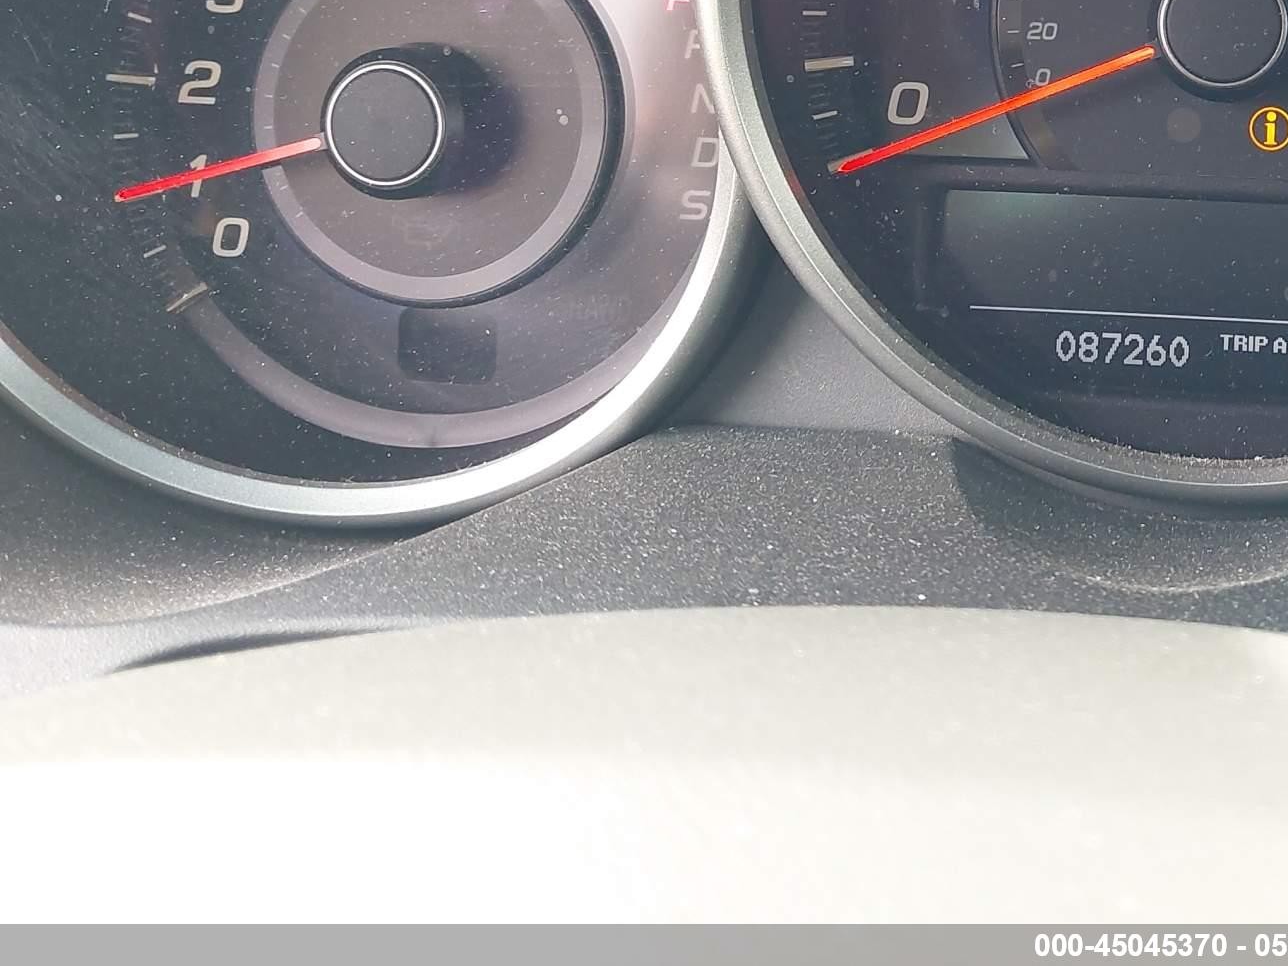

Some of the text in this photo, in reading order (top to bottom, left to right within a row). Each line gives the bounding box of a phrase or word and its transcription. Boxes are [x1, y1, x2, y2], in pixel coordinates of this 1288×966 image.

[1026, 21, 1058, 41] 20
[177, 60, 222, 105] 2
[1035, 68, 1051, 86] 0
[887, 81, 929, 125] 0
[691, 137, 719, 168] D
[190, 154, 208, 198] 1
[680, 190, 711, 220] S
[212, 217, 250, 257] 0
[1055, 330, 1190, 367] 087260
[1219, 334, 1268, 354] TRIP
[1273, 337, 1287, 354] A
